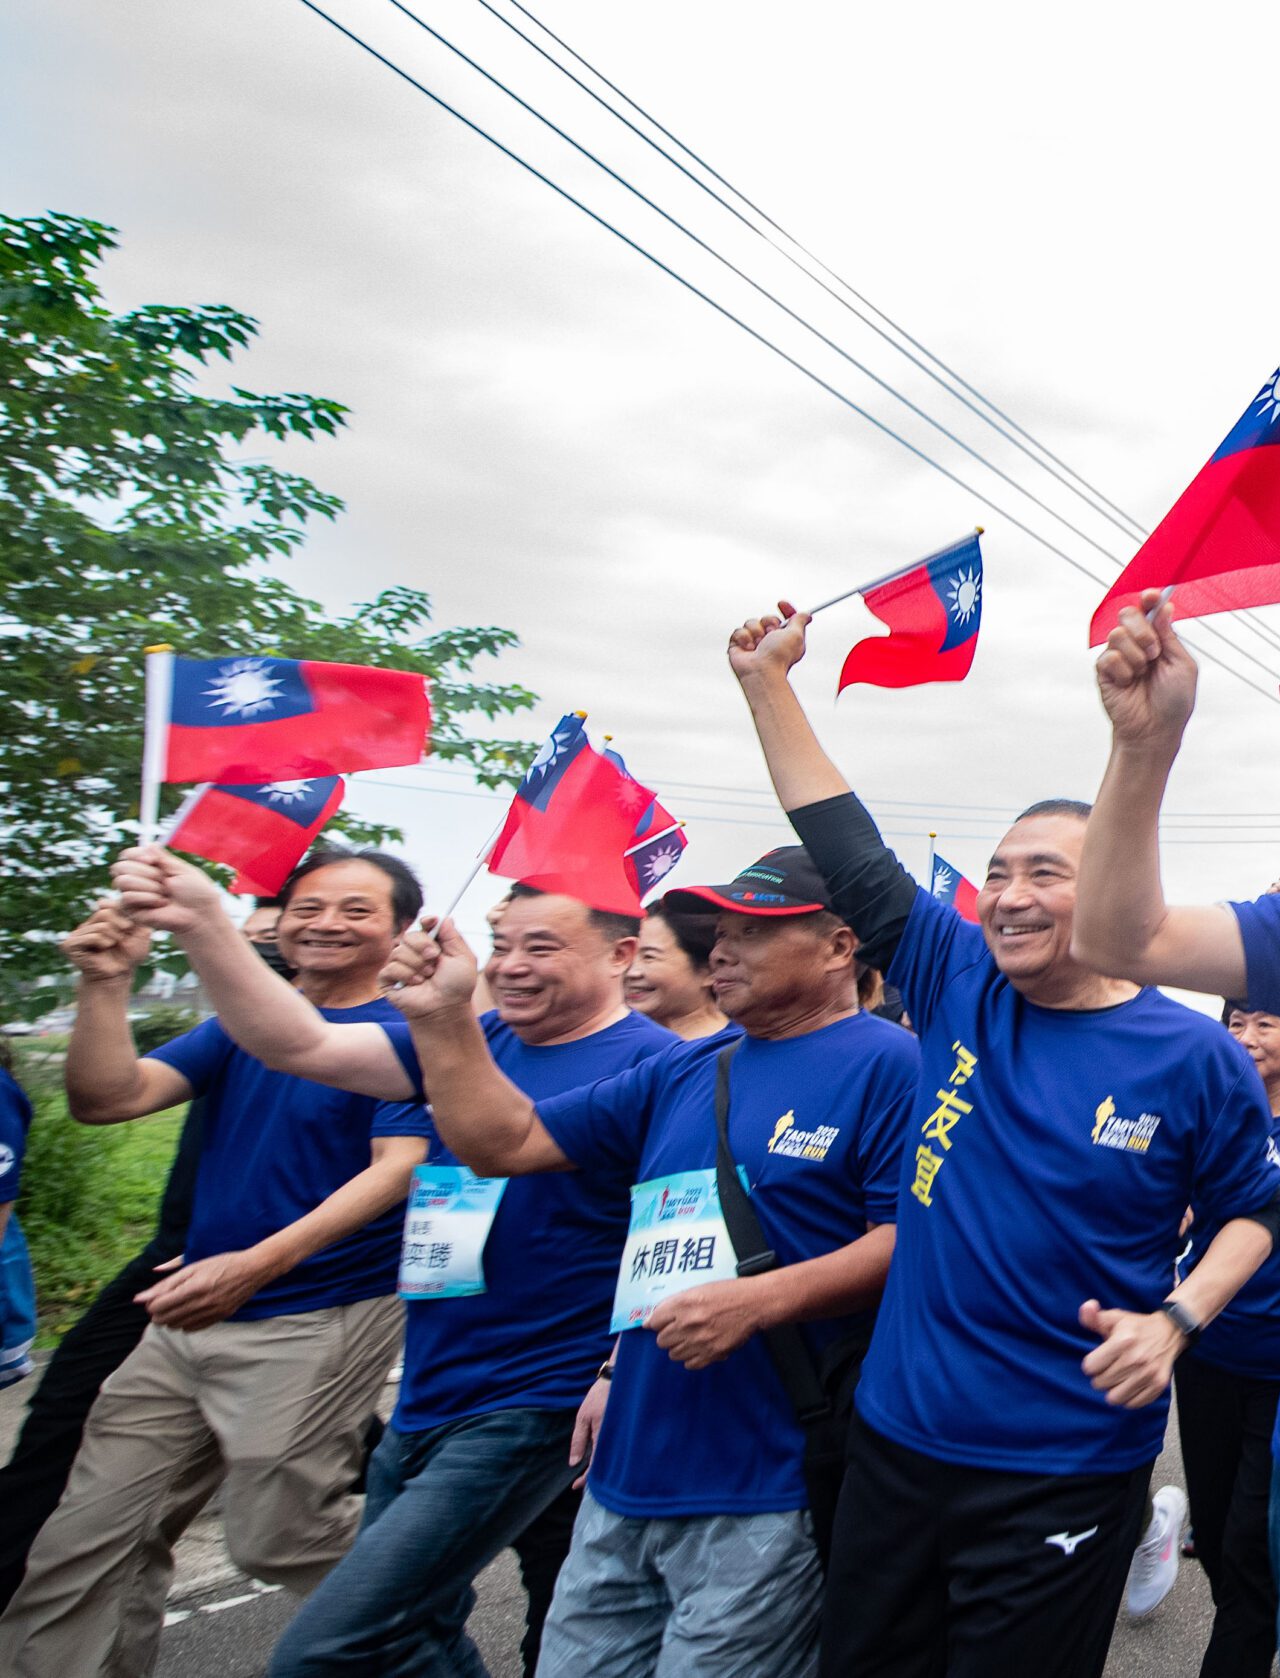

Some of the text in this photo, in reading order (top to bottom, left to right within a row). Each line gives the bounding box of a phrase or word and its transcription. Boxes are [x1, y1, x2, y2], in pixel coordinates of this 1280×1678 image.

[1103, 1115, 1157, 1139] TAOYUAN
[781, 1128, 837, 1149] TAOYUAN
[1126, 1135, 1152, 1152] RUN
[801, 1144, 828, 1159] RUN
[630, 1235, 718, 1284] 休閒組
